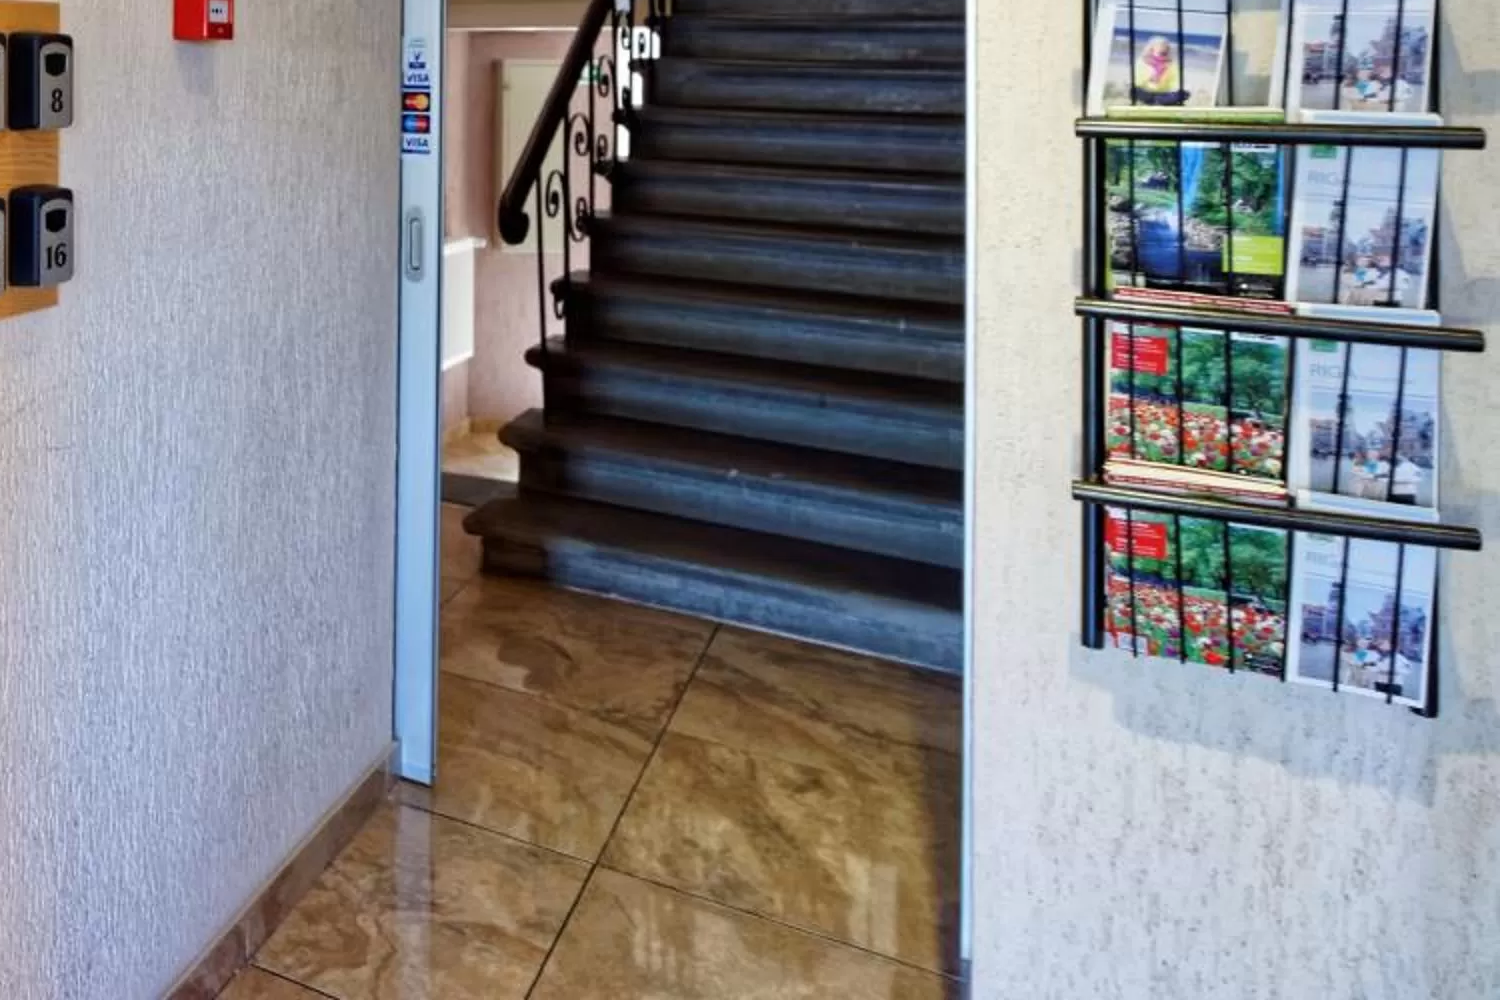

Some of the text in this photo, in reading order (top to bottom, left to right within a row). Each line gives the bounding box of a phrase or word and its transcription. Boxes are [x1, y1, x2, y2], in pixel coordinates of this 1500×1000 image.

[406, 73, 429, 83] VISA
[50, 87, 64, 113] 8
[406, 138, 429, 148] VISA
[45, 242, 68, 270] 16
